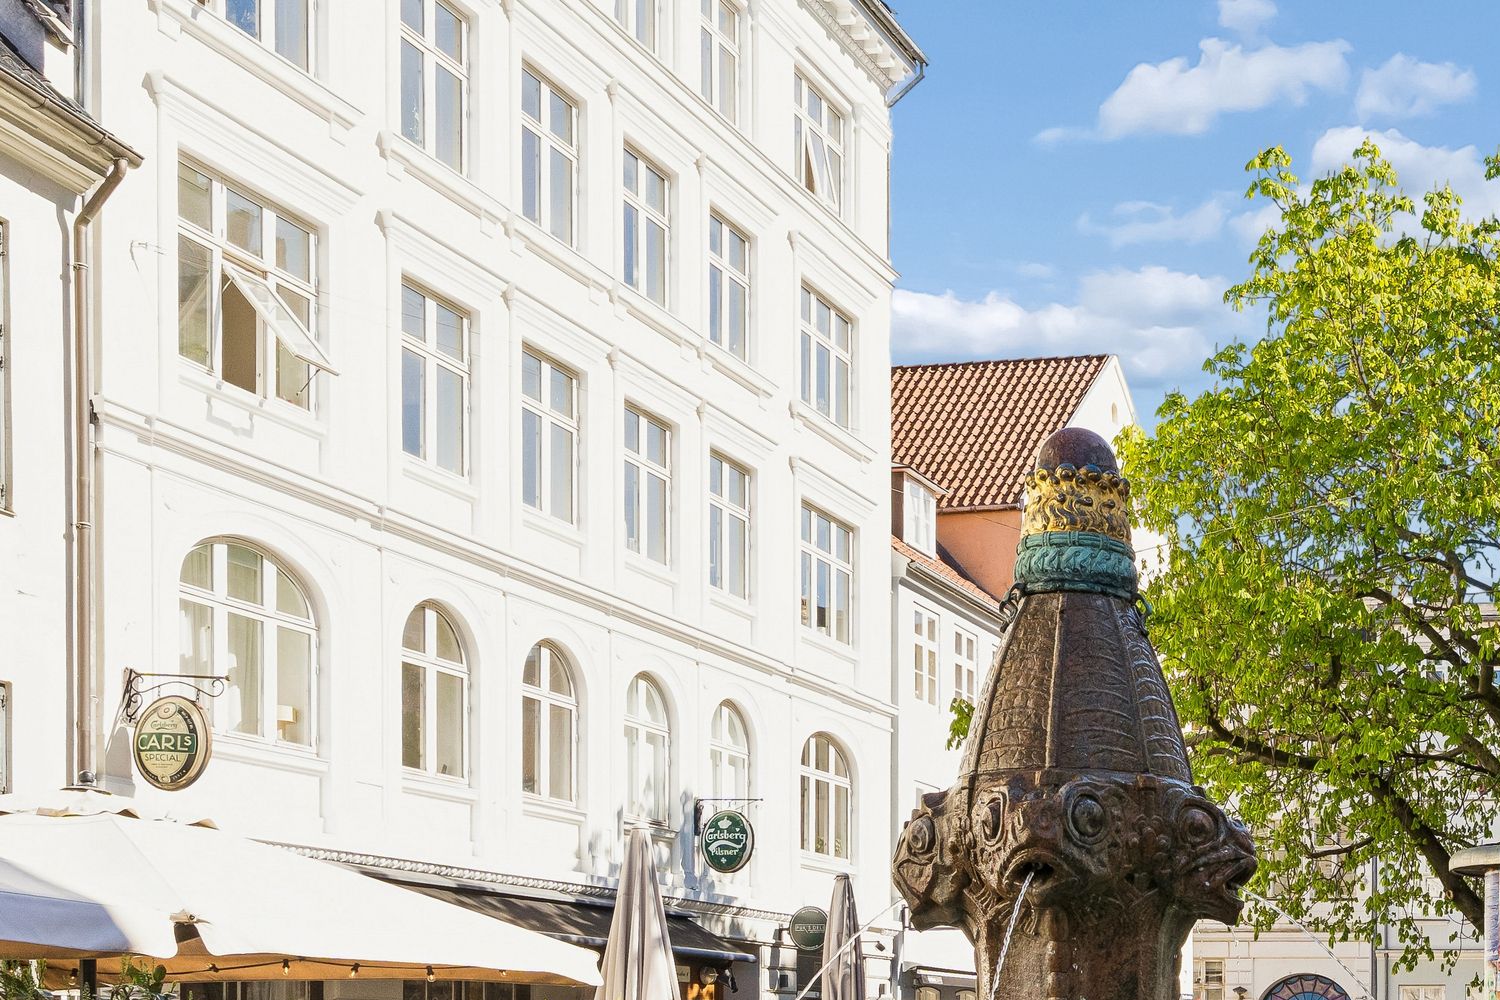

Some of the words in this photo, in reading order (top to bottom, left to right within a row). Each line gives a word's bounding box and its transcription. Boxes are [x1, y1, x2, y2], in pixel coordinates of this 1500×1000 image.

[151, 720, 178, 730] Carlsberg
[145, 753, 181, 762] SPECIAL
[706, 828, 746, 845] Carlsberg
[711, 847, 739, 856] Pilsner
